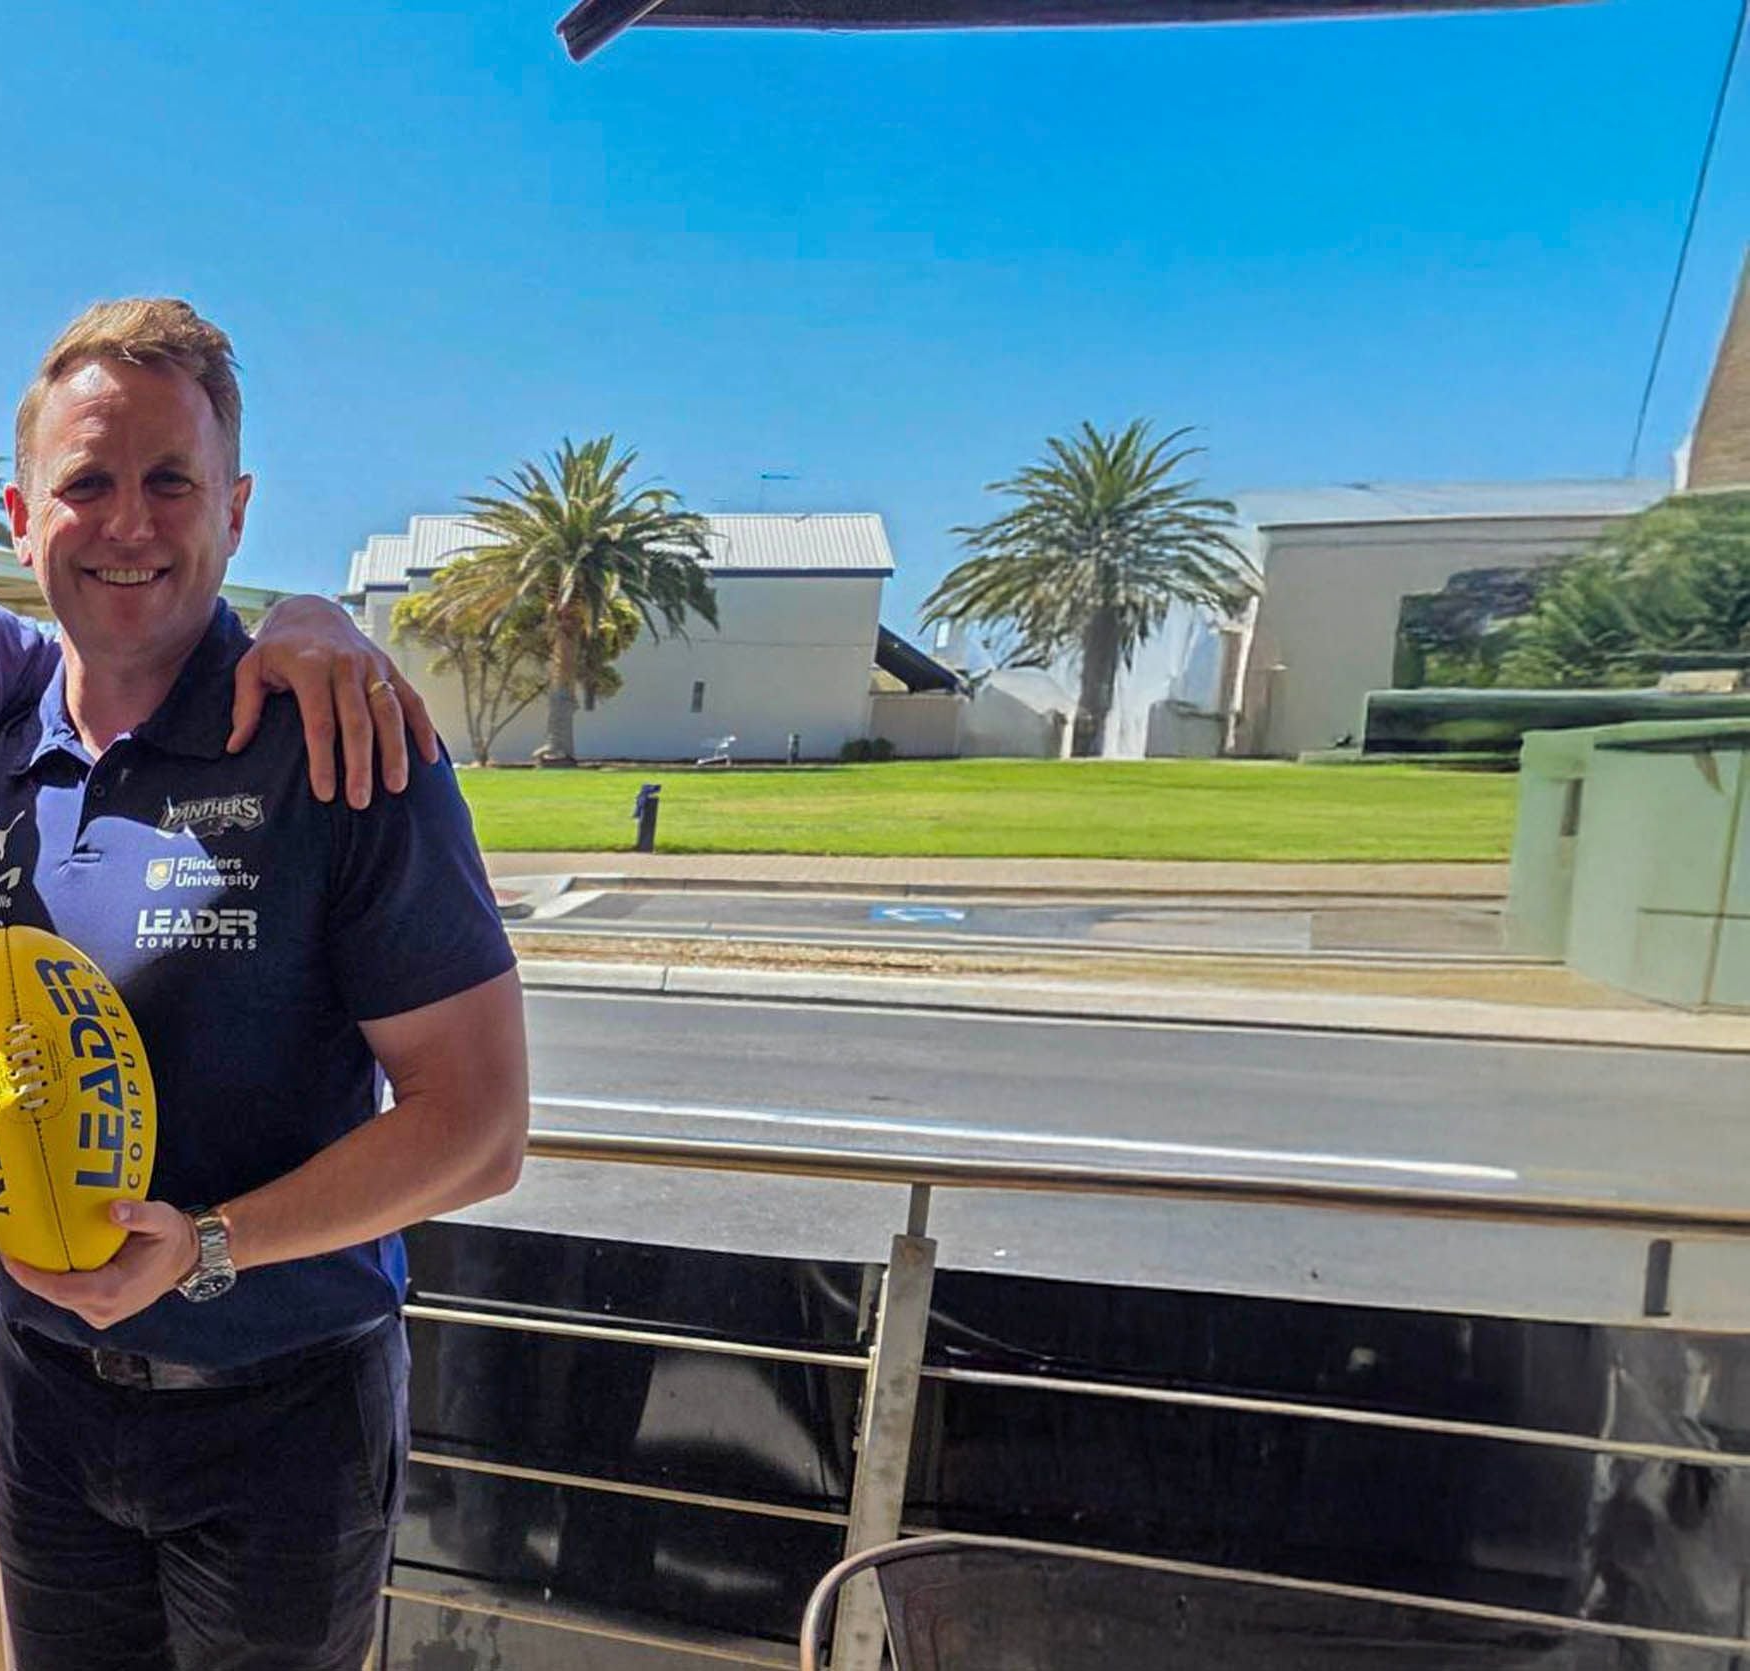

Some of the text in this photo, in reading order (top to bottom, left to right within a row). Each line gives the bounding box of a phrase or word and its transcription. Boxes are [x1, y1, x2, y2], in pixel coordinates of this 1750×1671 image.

[160, 797, 260, 829] PANTHERS
[177, 856, 242, 871] Flinders
[175, 872, 260, 890] University
[137, 909, 258, 935] LEADER
[136, 938, 257, 949] COMPUTERS
[35, 958, 124, 1188] LEADER
[82, 961, 144, 1189] COMPUTERS
